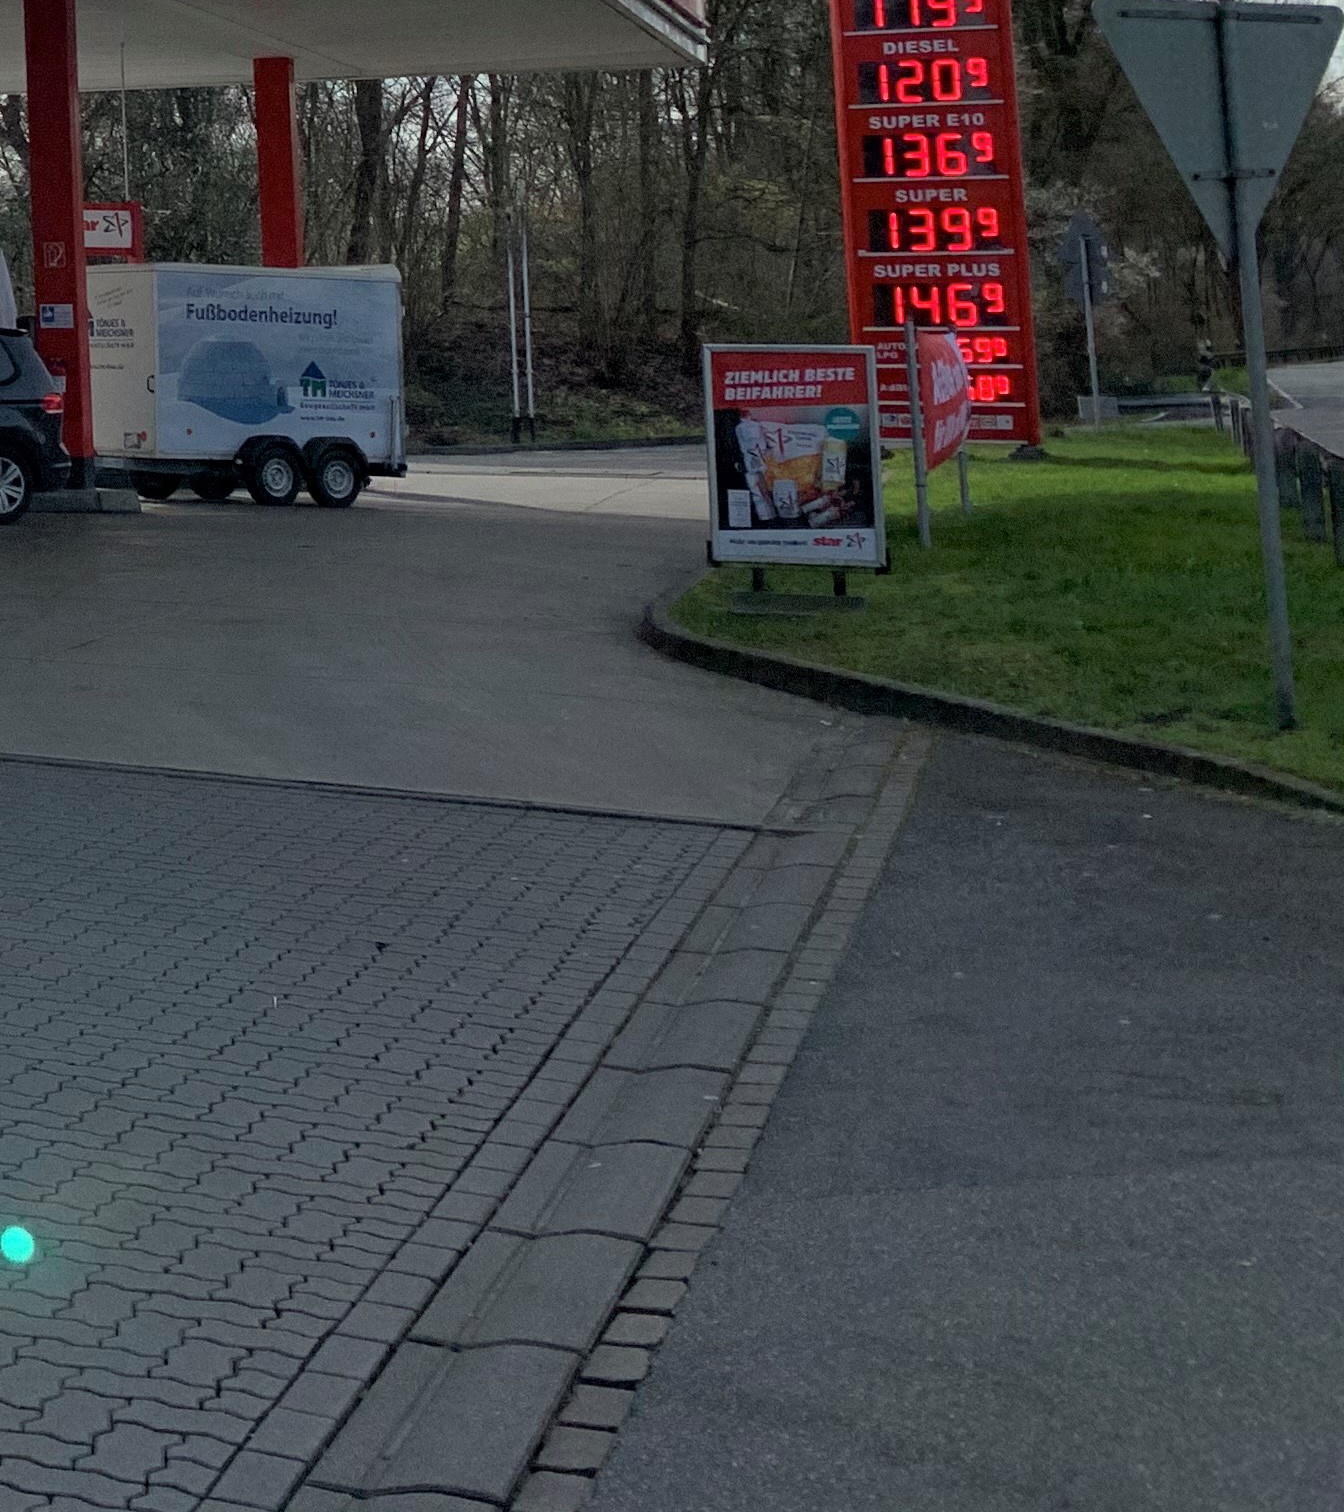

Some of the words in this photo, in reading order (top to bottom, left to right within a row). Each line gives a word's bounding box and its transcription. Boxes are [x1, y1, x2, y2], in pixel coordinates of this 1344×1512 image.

[883, 40, 959, 55] DIESEL
[868, 114, 940, 129] SUPER
[947, 113, 984, 126] E10
[895, 189, 968, 203] SUPER
[874, 263, 941, 278] SUPER
[947, 262, 1000, 277] PLUS
[186, 303, 338, 329] Fußbodenheizung!
[724, 369, 799, 385] ZIEMLICH
[804, 367, 855, 382] BESTE
[724, 385, 822, 401] BEIFAHRER!
